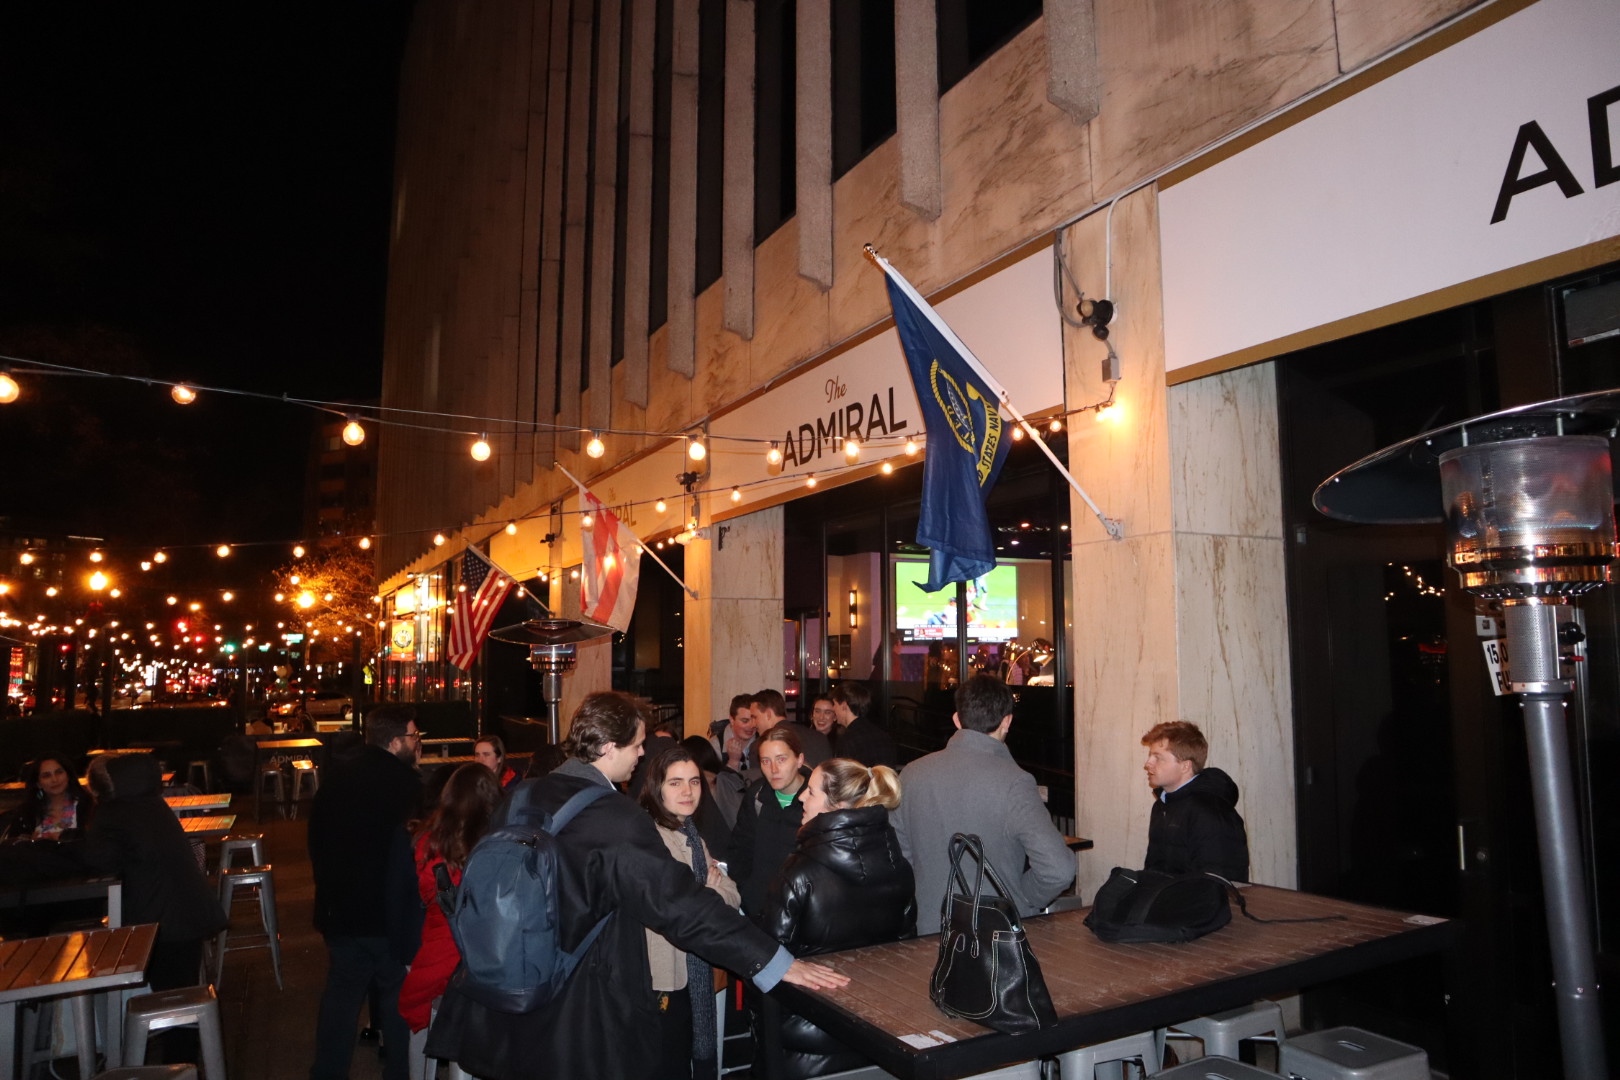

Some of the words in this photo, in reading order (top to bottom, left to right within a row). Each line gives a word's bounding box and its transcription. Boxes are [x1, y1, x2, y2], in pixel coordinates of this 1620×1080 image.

[824, 376, 848, 403] The
[781, 386, 908, 472] ADMIRAL
[986, 404, 999, 432] NAVY
[981, 433, 997, 469] STATES
